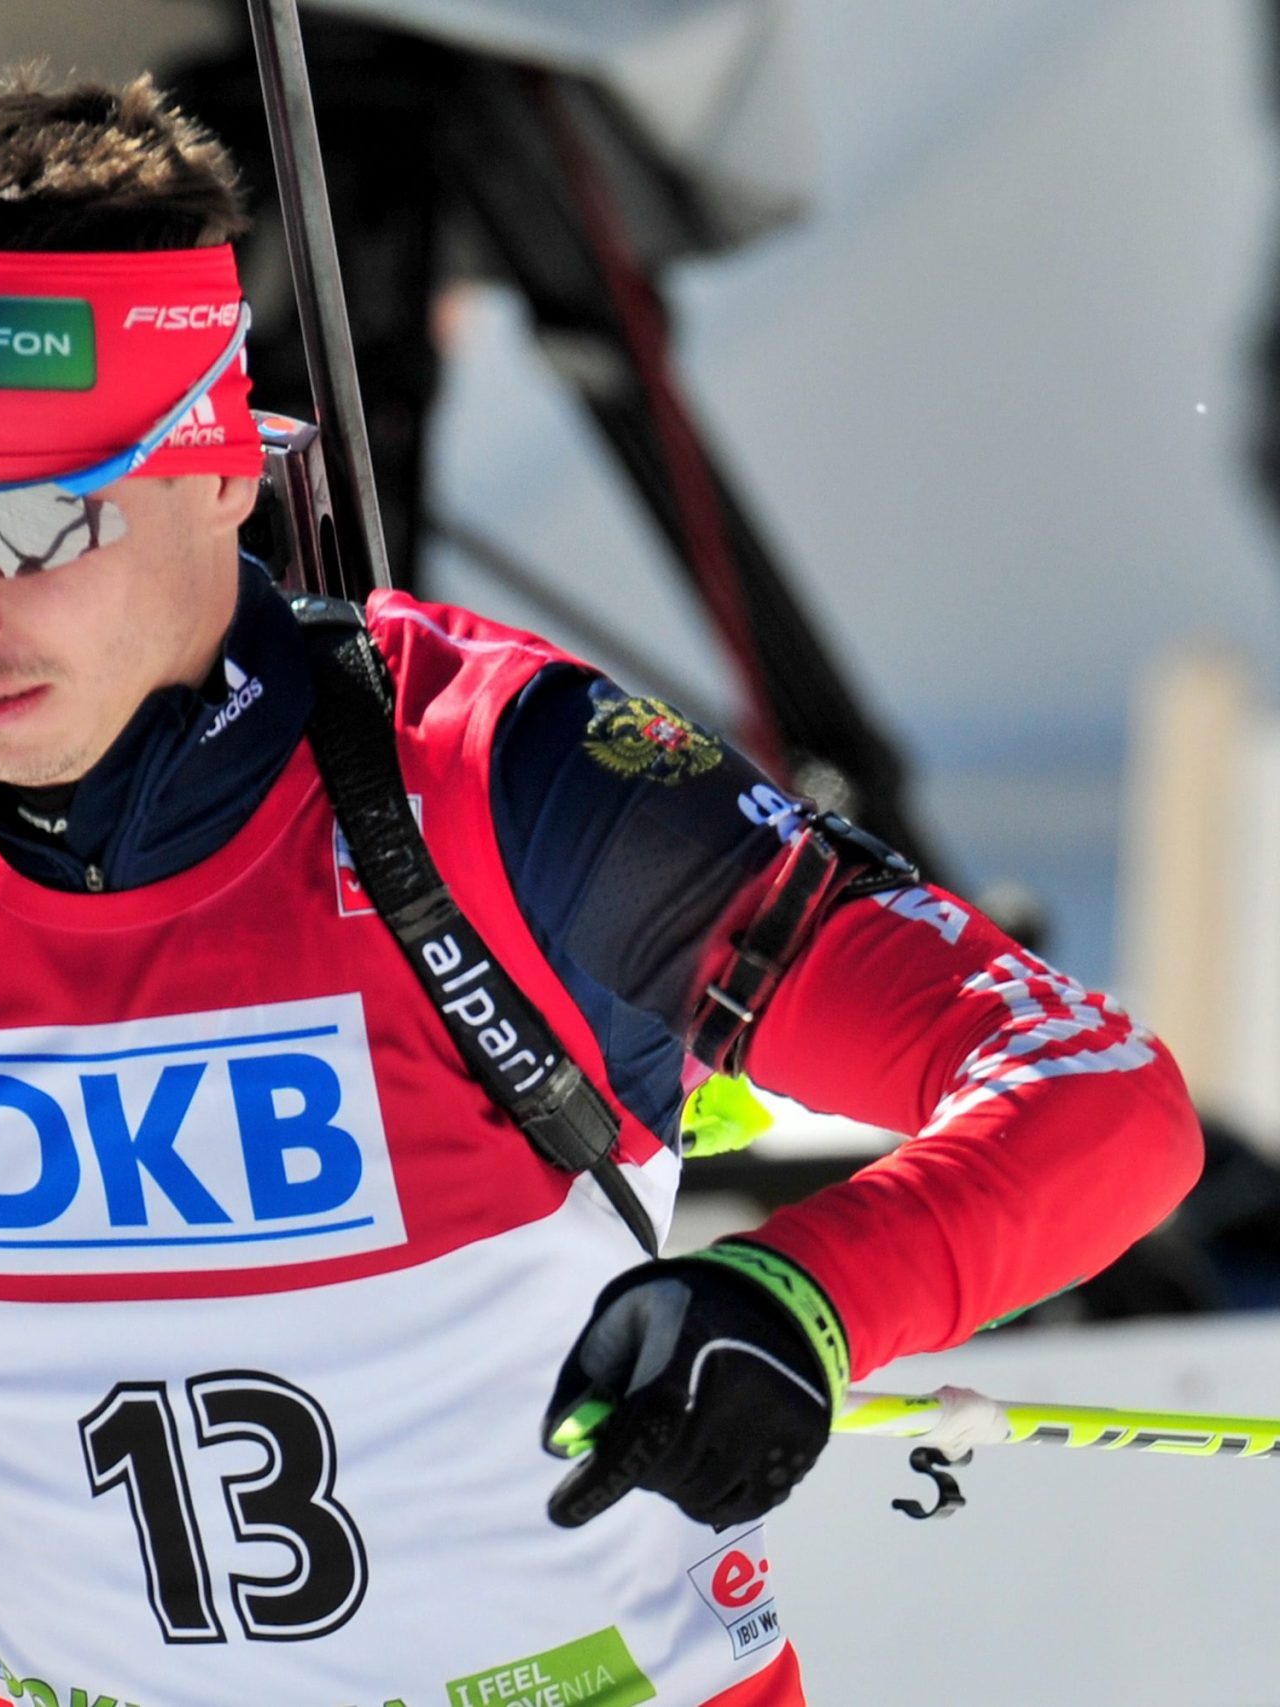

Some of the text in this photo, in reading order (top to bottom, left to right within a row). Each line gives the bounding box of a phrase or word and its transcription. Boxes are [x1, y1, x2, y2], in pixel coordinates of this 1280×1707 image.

[422, 934, 555, 1093] alpari
[77, 1369, 369, 1645] 13
[477, 1661, 551, 1706] FEEL
[736, 1619, 759, 1648] IBU
